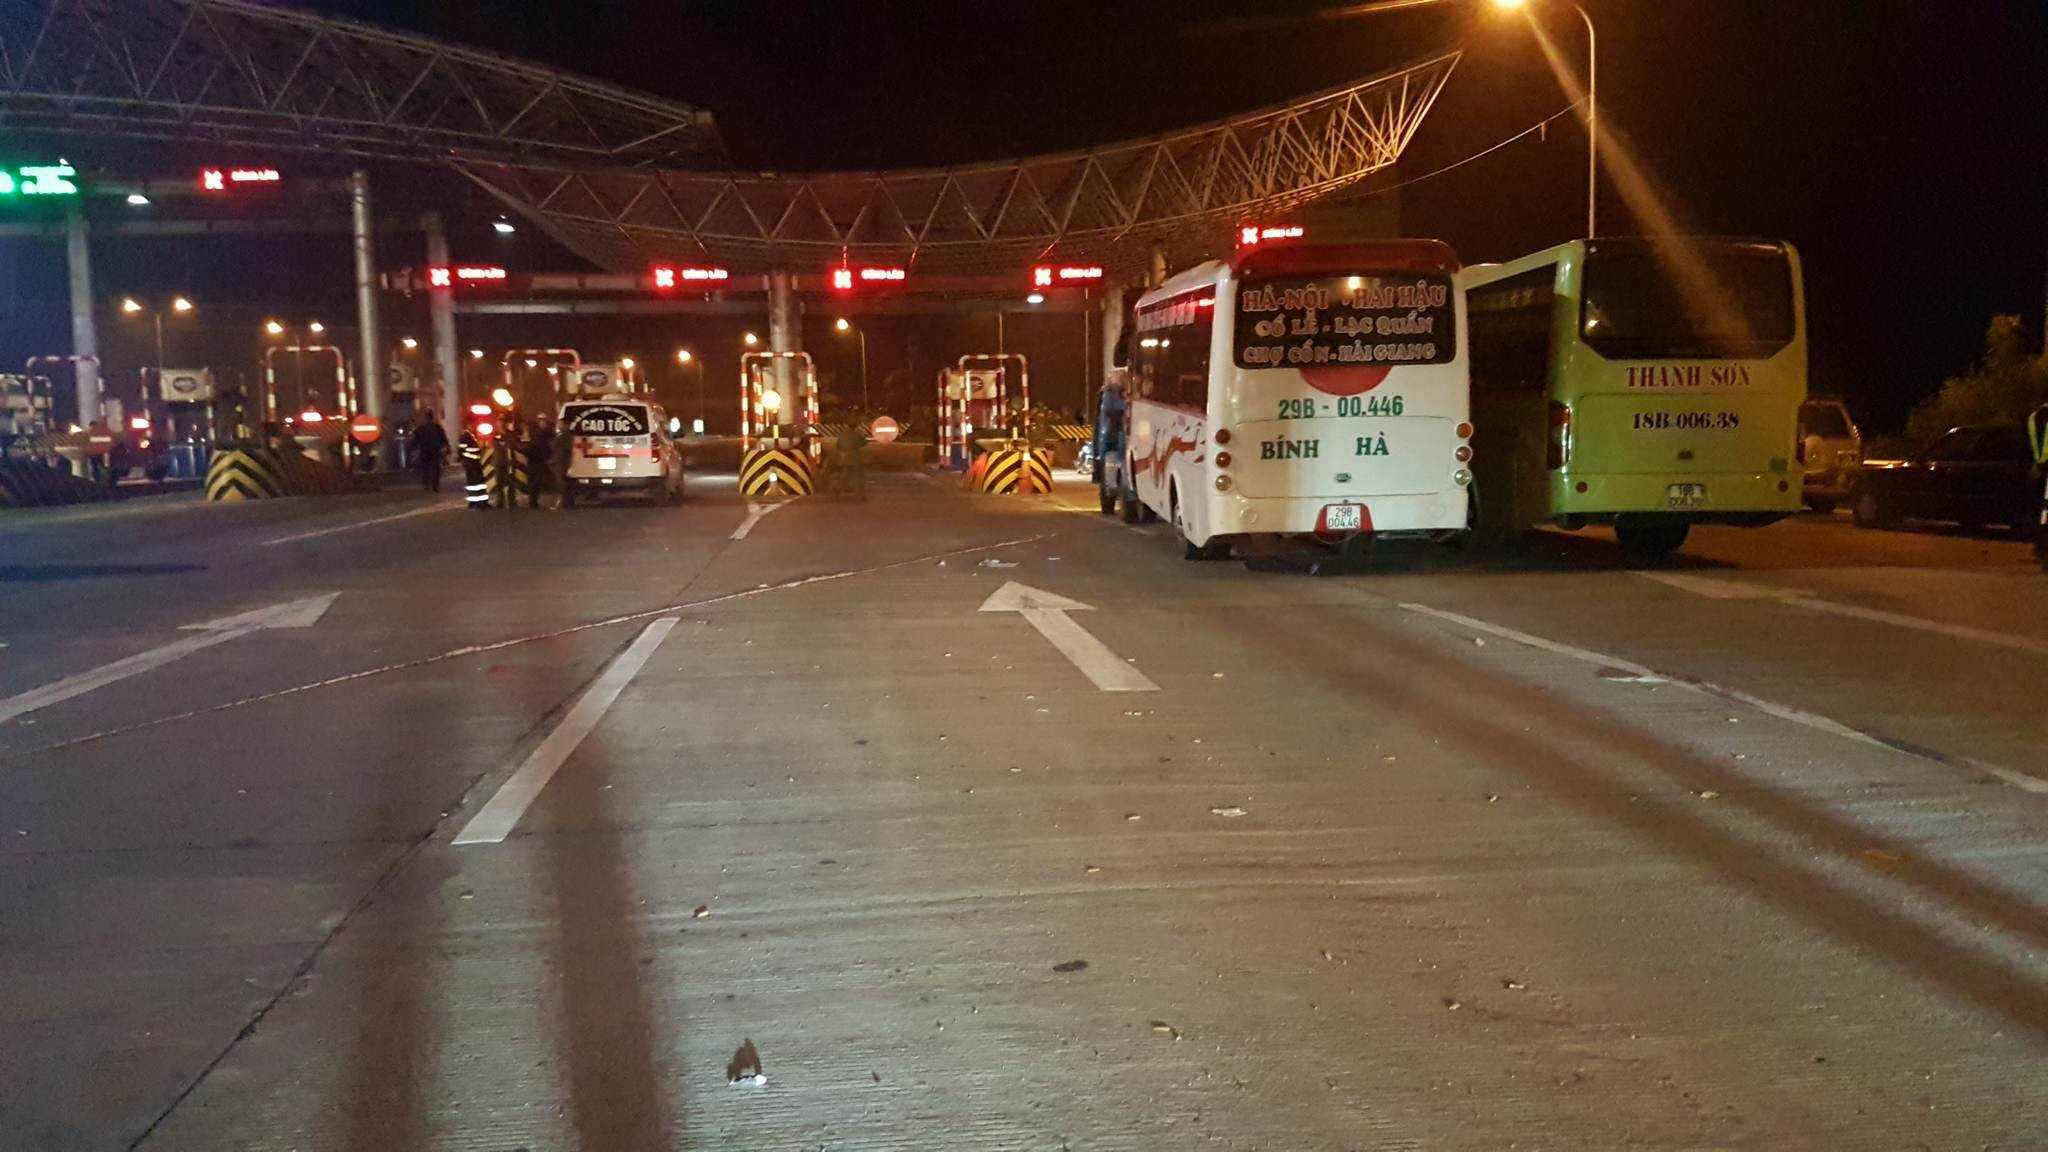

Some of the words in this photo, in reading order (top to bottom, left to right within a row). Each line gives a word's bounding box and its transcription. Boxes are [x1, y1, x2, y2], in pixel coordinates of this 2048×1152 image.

[1626, 366, 1701, 387] THANH
[1711, 362, 1750, 386] SƠN
[1278, 398, 1315, 419] 29B
[1337, 396, 1404, 417] 00.446
[582, 419, 605, 432] CAO
[1354, 431, 1390, 456] HÀ
